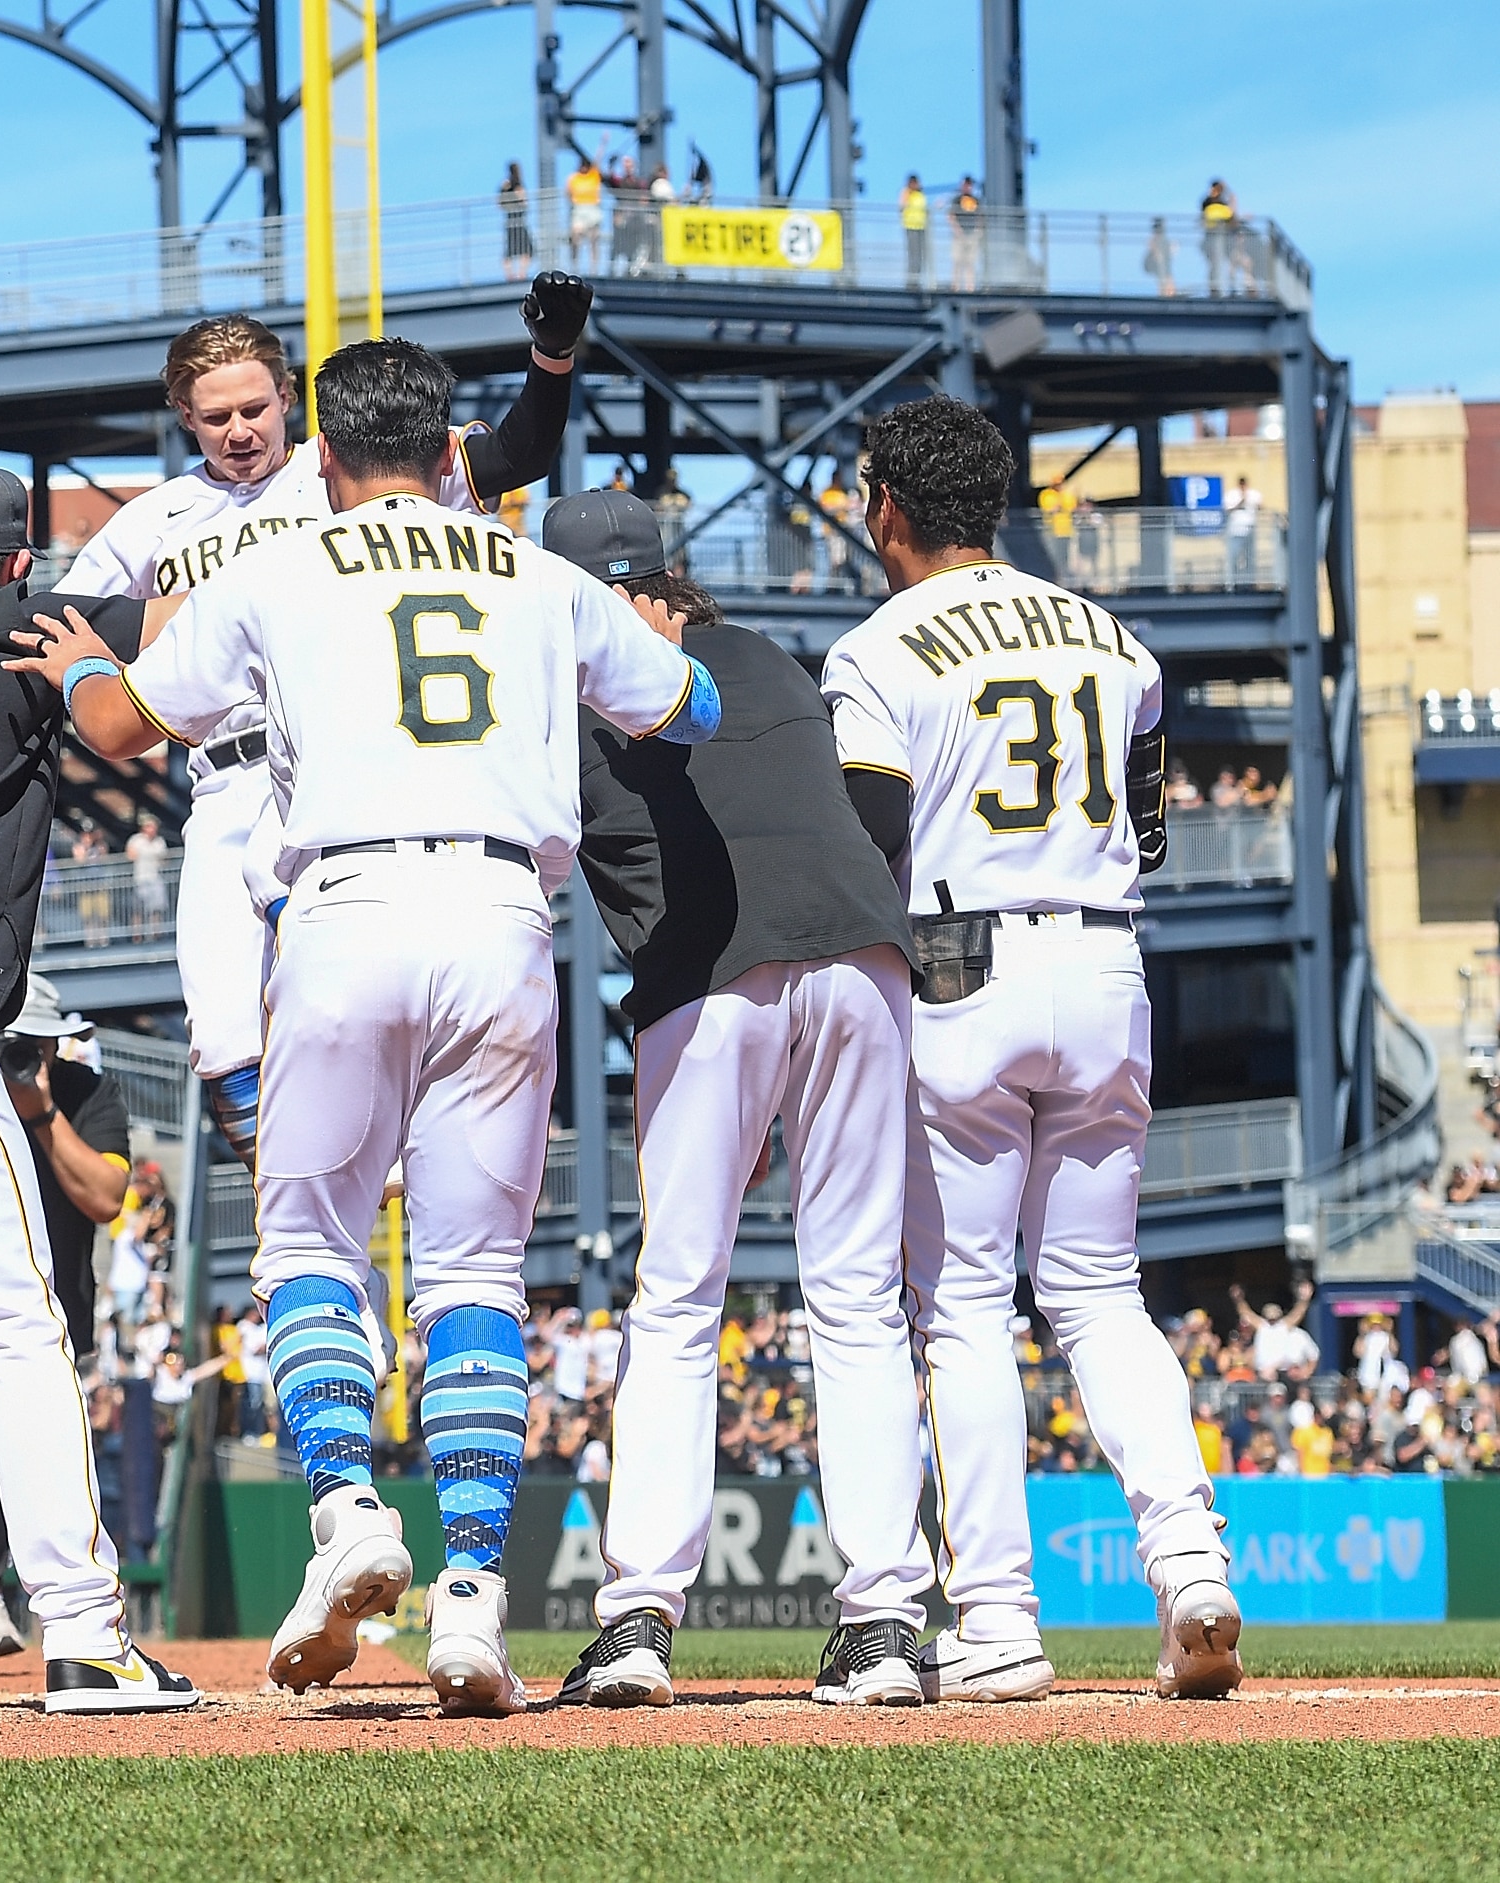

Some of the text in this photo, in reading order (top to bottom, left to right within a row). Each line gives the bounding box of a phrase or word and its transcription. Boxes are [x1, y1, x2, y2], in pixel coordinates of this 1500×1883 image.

[684, 221, 814, 255] RETIRE 21
[1185, 476, 1210, 510] P
[320, 522, 517, 579] CHANG
[384, 590, 502, 748] 6
[898, 595, 1138, 679] MITCHELL
[970, 672, 1118, 835] 31
